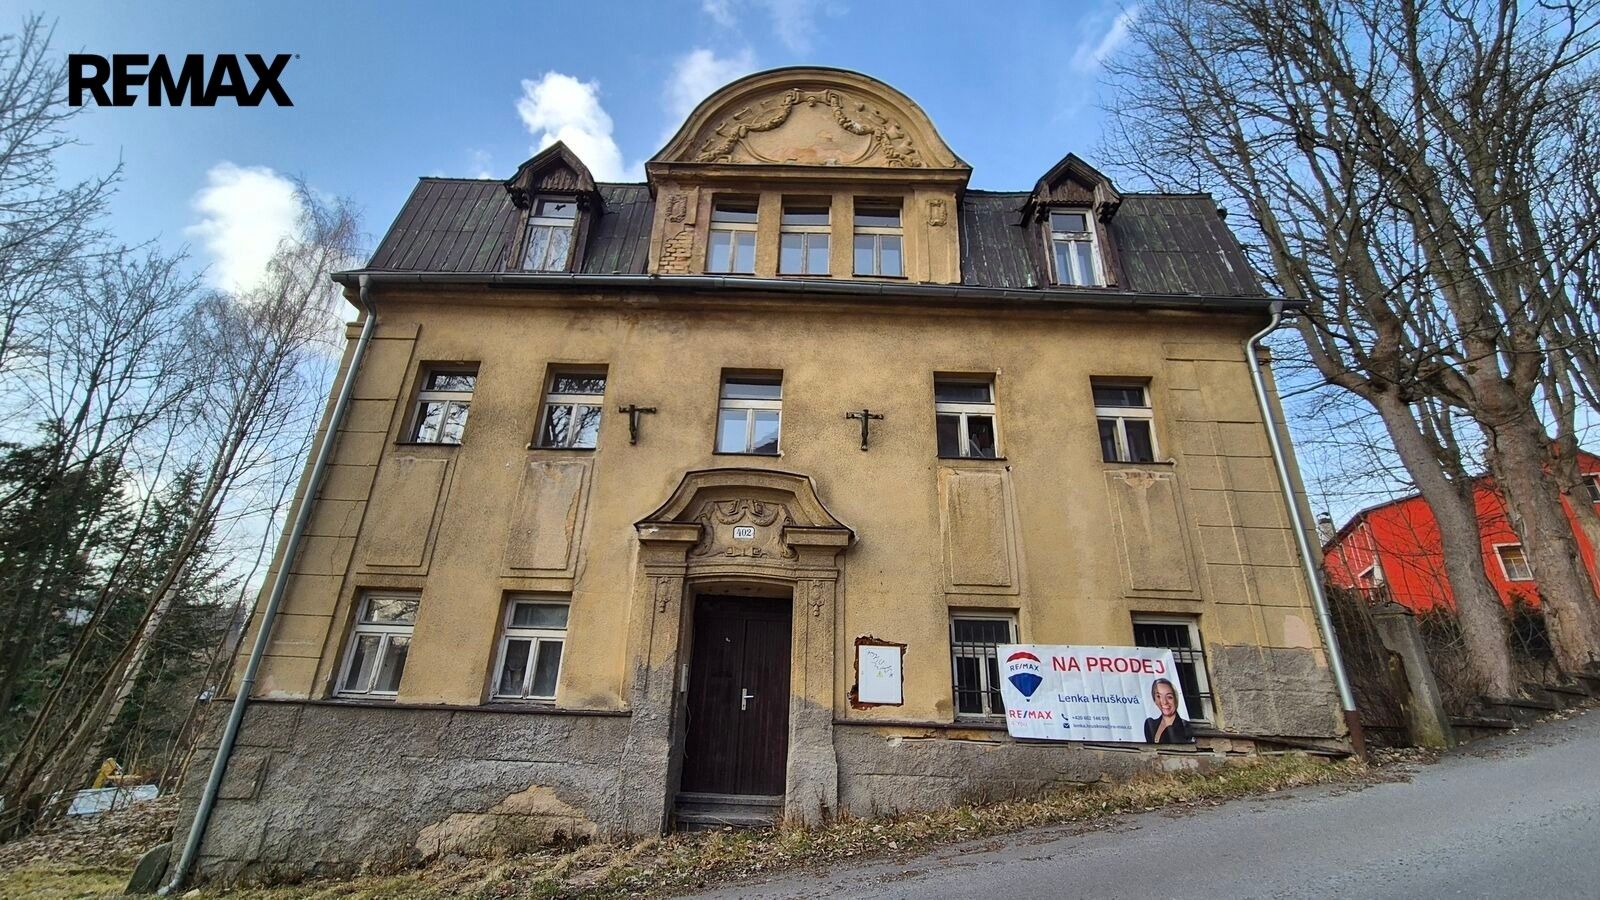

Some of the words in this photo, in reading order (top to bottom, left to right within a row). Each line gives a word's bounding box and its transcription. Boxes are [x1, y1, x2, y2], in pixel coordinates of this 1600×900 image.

[736, 528, 752, 537] 402
[1009, 663, 1040, 673] RE/MAX
[1052, 656, 1081, 672] NA
[1086, 657, 1165, 674] PRODEJ
[1058, 693, 1090, 703] Lenka
[1091, 693, 1140, 705] Hrušková
[1009, 709, 1053, 720] RE/MAX
